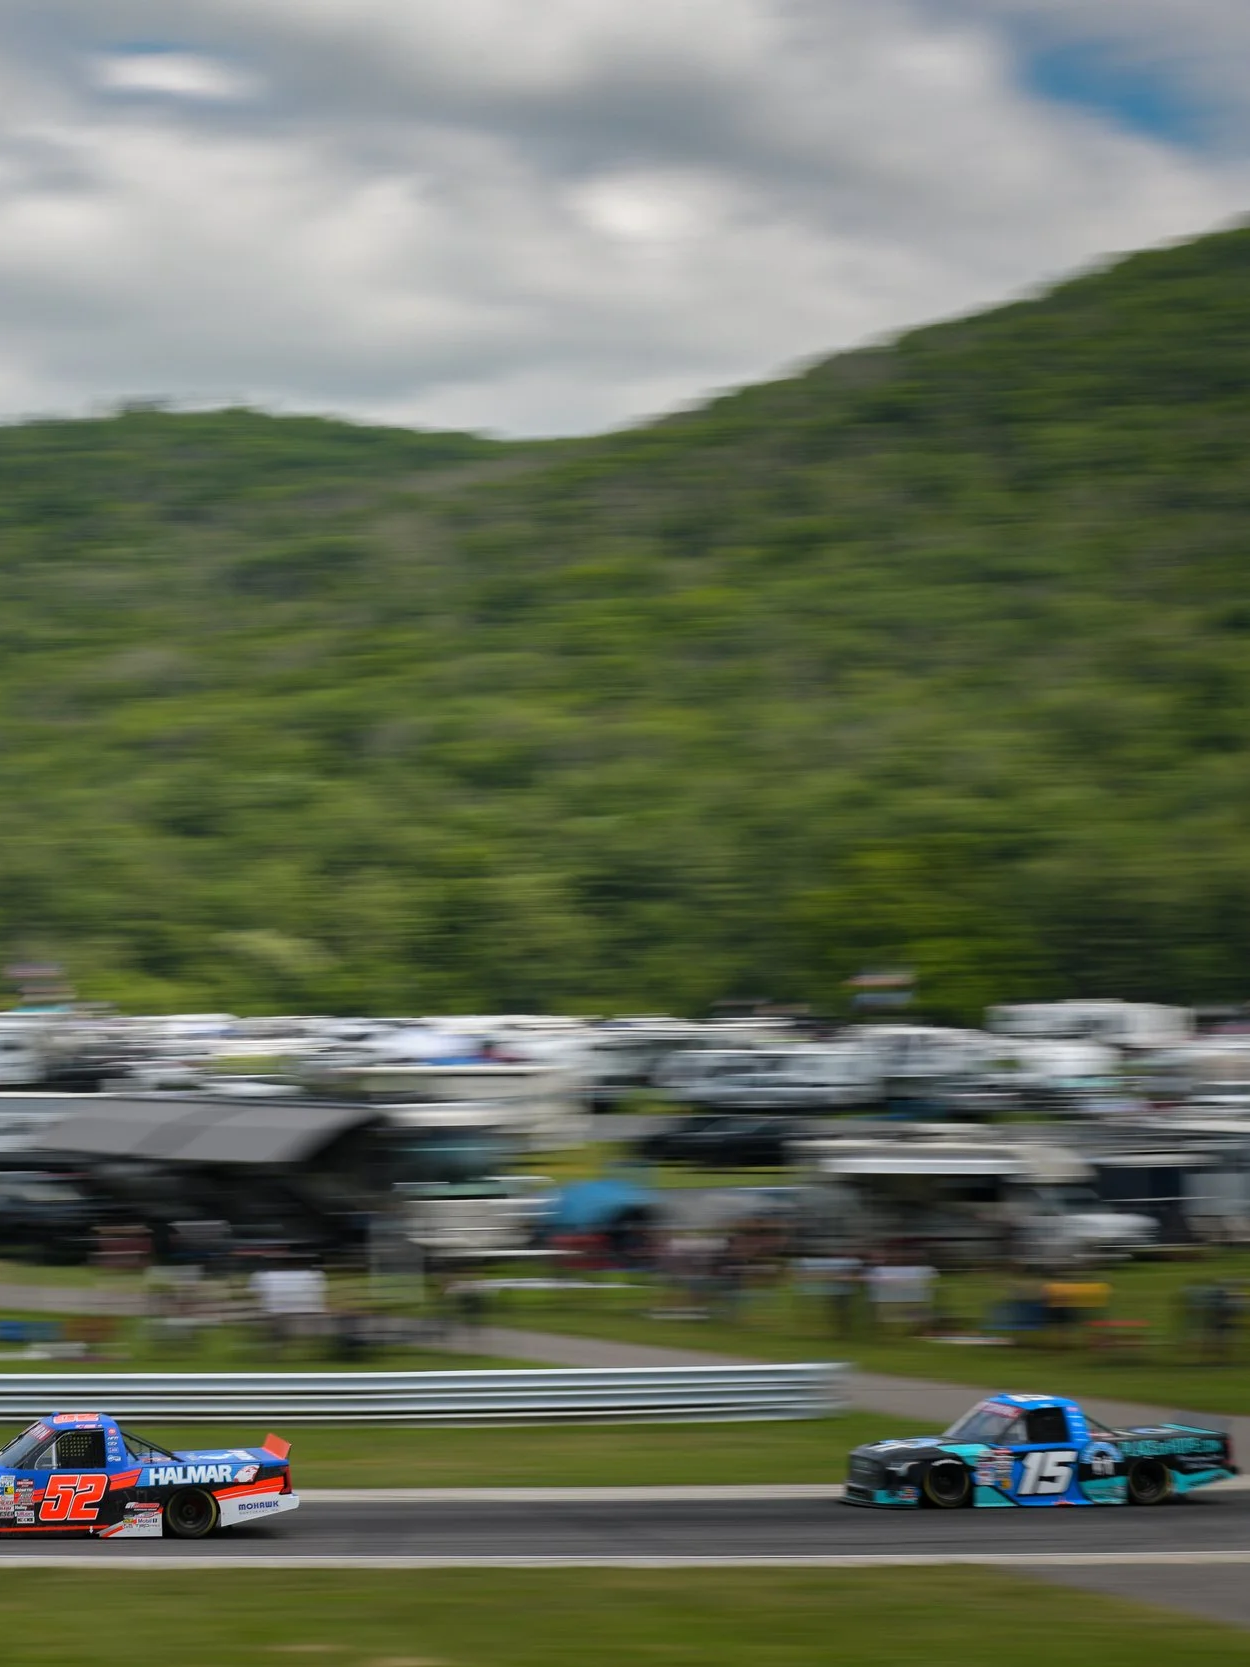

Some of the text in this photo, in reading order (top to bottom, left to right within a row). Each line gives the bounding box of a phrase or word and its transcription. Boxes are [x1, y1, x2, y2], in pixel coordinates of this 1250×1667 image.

[150, 1464, 232, 1486] HALMAR
[1016, 1451, 1078, 1495] 15
[39, 1474, 108, 1521] 52
[238, 1500, 279, 1511] MOHAWK
